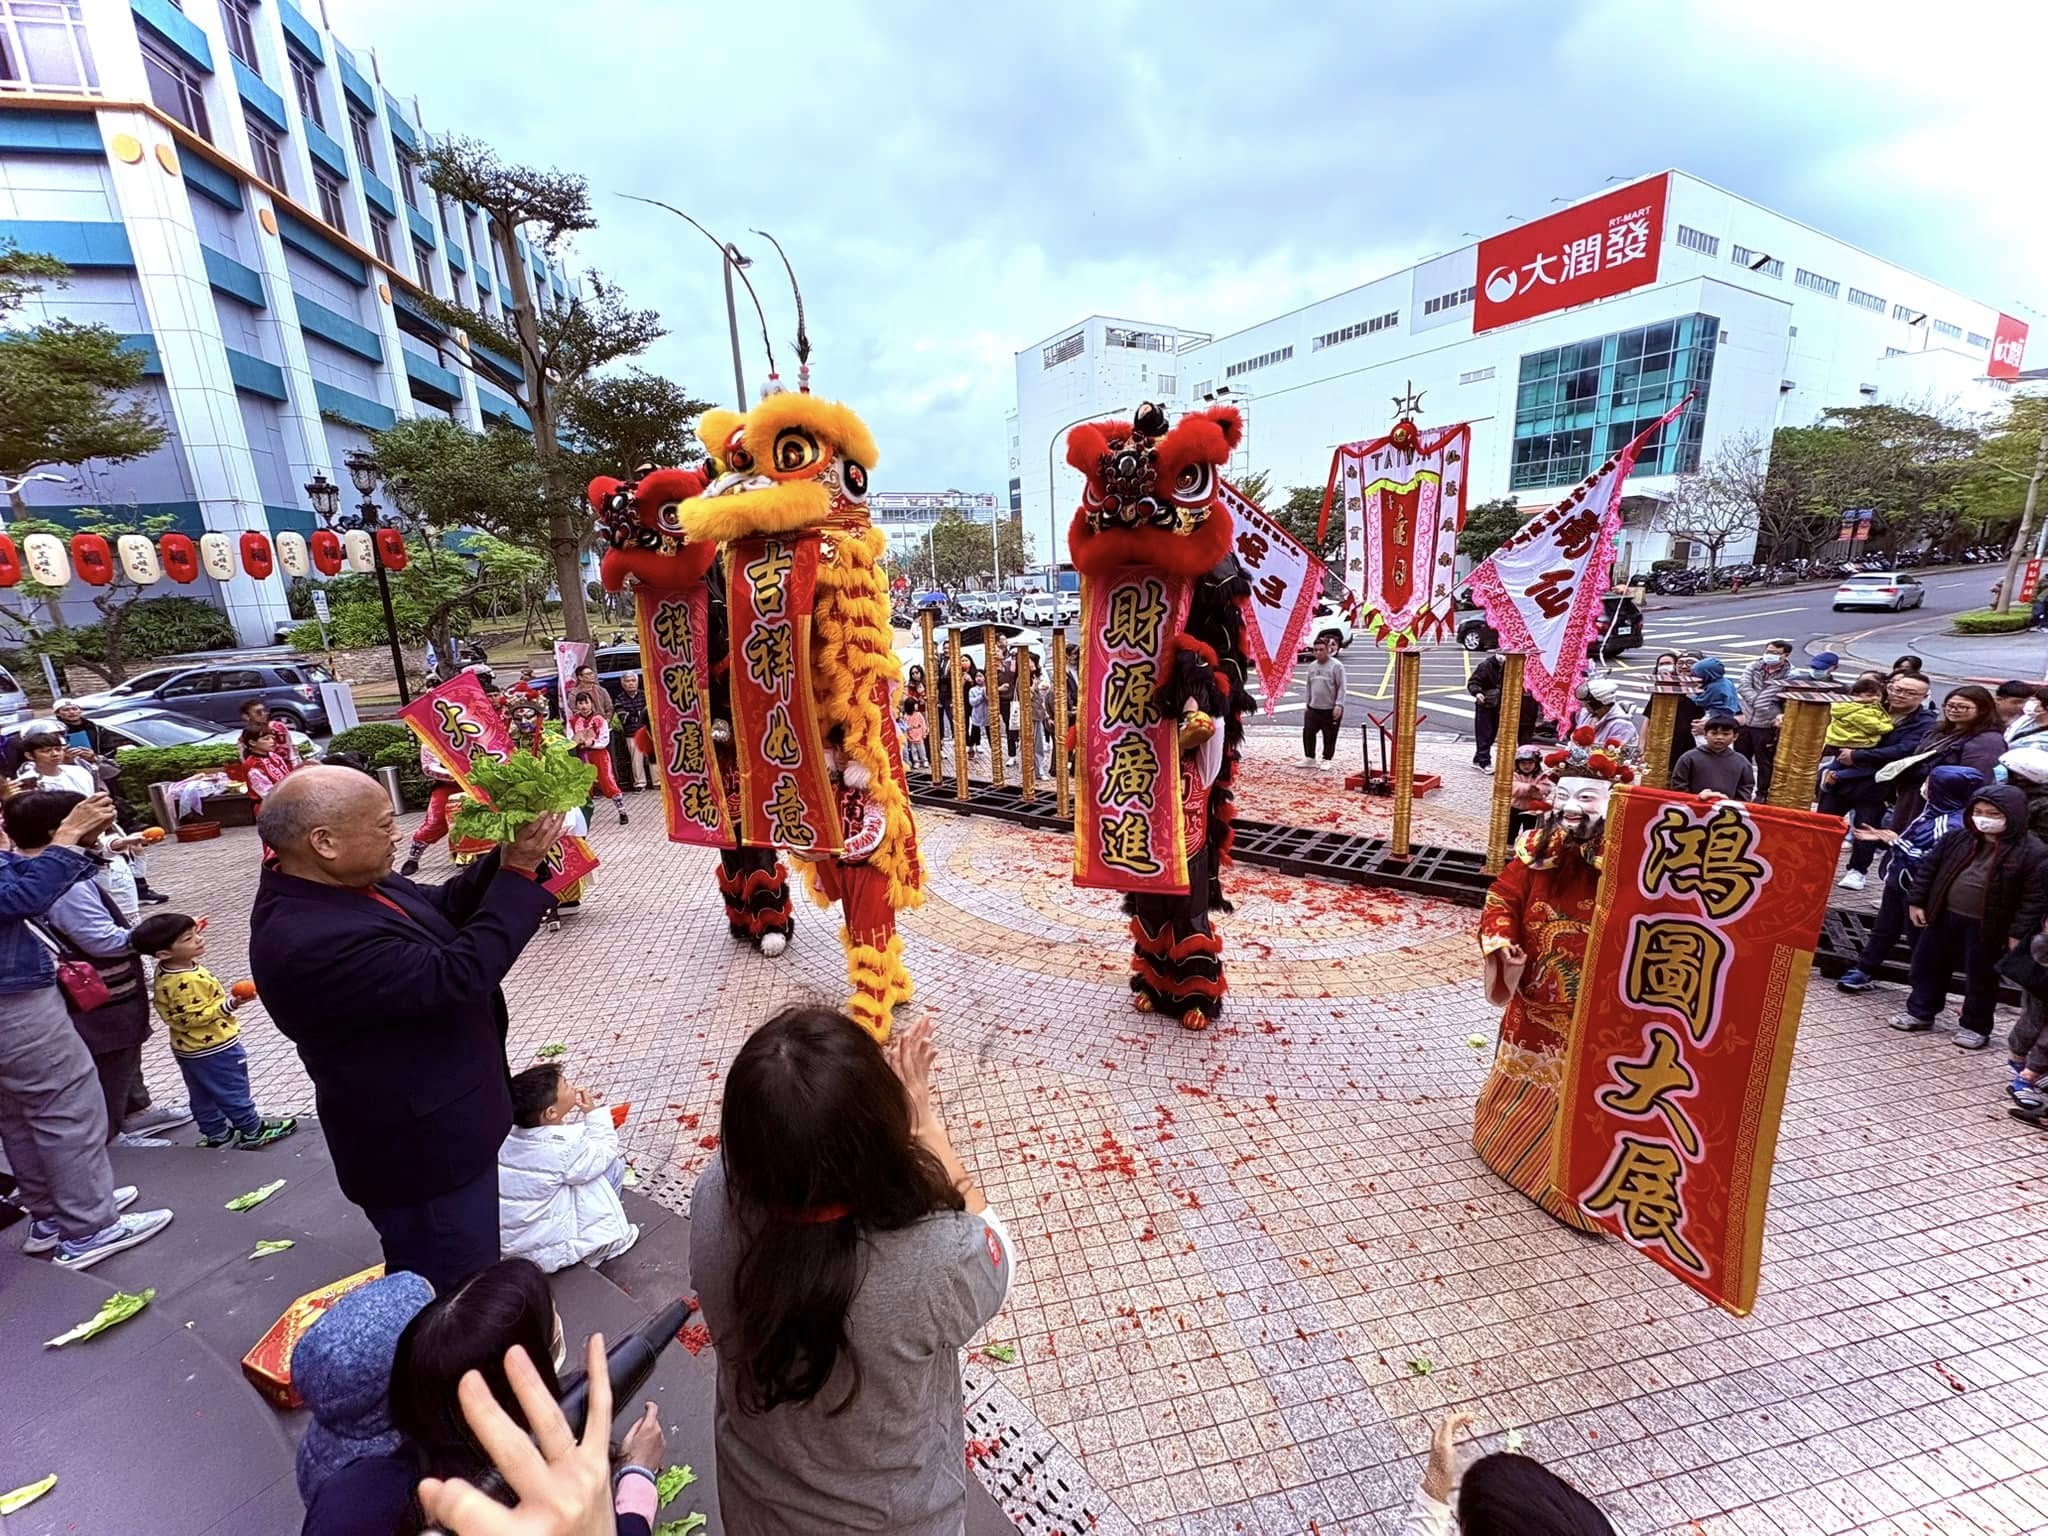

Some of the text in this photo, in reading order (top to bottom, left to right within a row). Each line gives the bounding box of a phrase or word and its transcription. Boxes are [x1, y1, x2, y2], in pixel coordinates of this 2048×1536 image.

[1518, 219, 1650, 296] 大潤發
[1608, 206, 1652, 228] RT-MART
[1370, 442, 1433, 471] TAIW
[1235, 531, 1288, 609] 南仙
[1524, 508, 1602, 620] 南仙
[746, 541, 814, 846] 吉祥如意
[1099, 579, 1167, 875] 財源廣進
[1584, 805, 1765, 1274] 鴻圖大展
